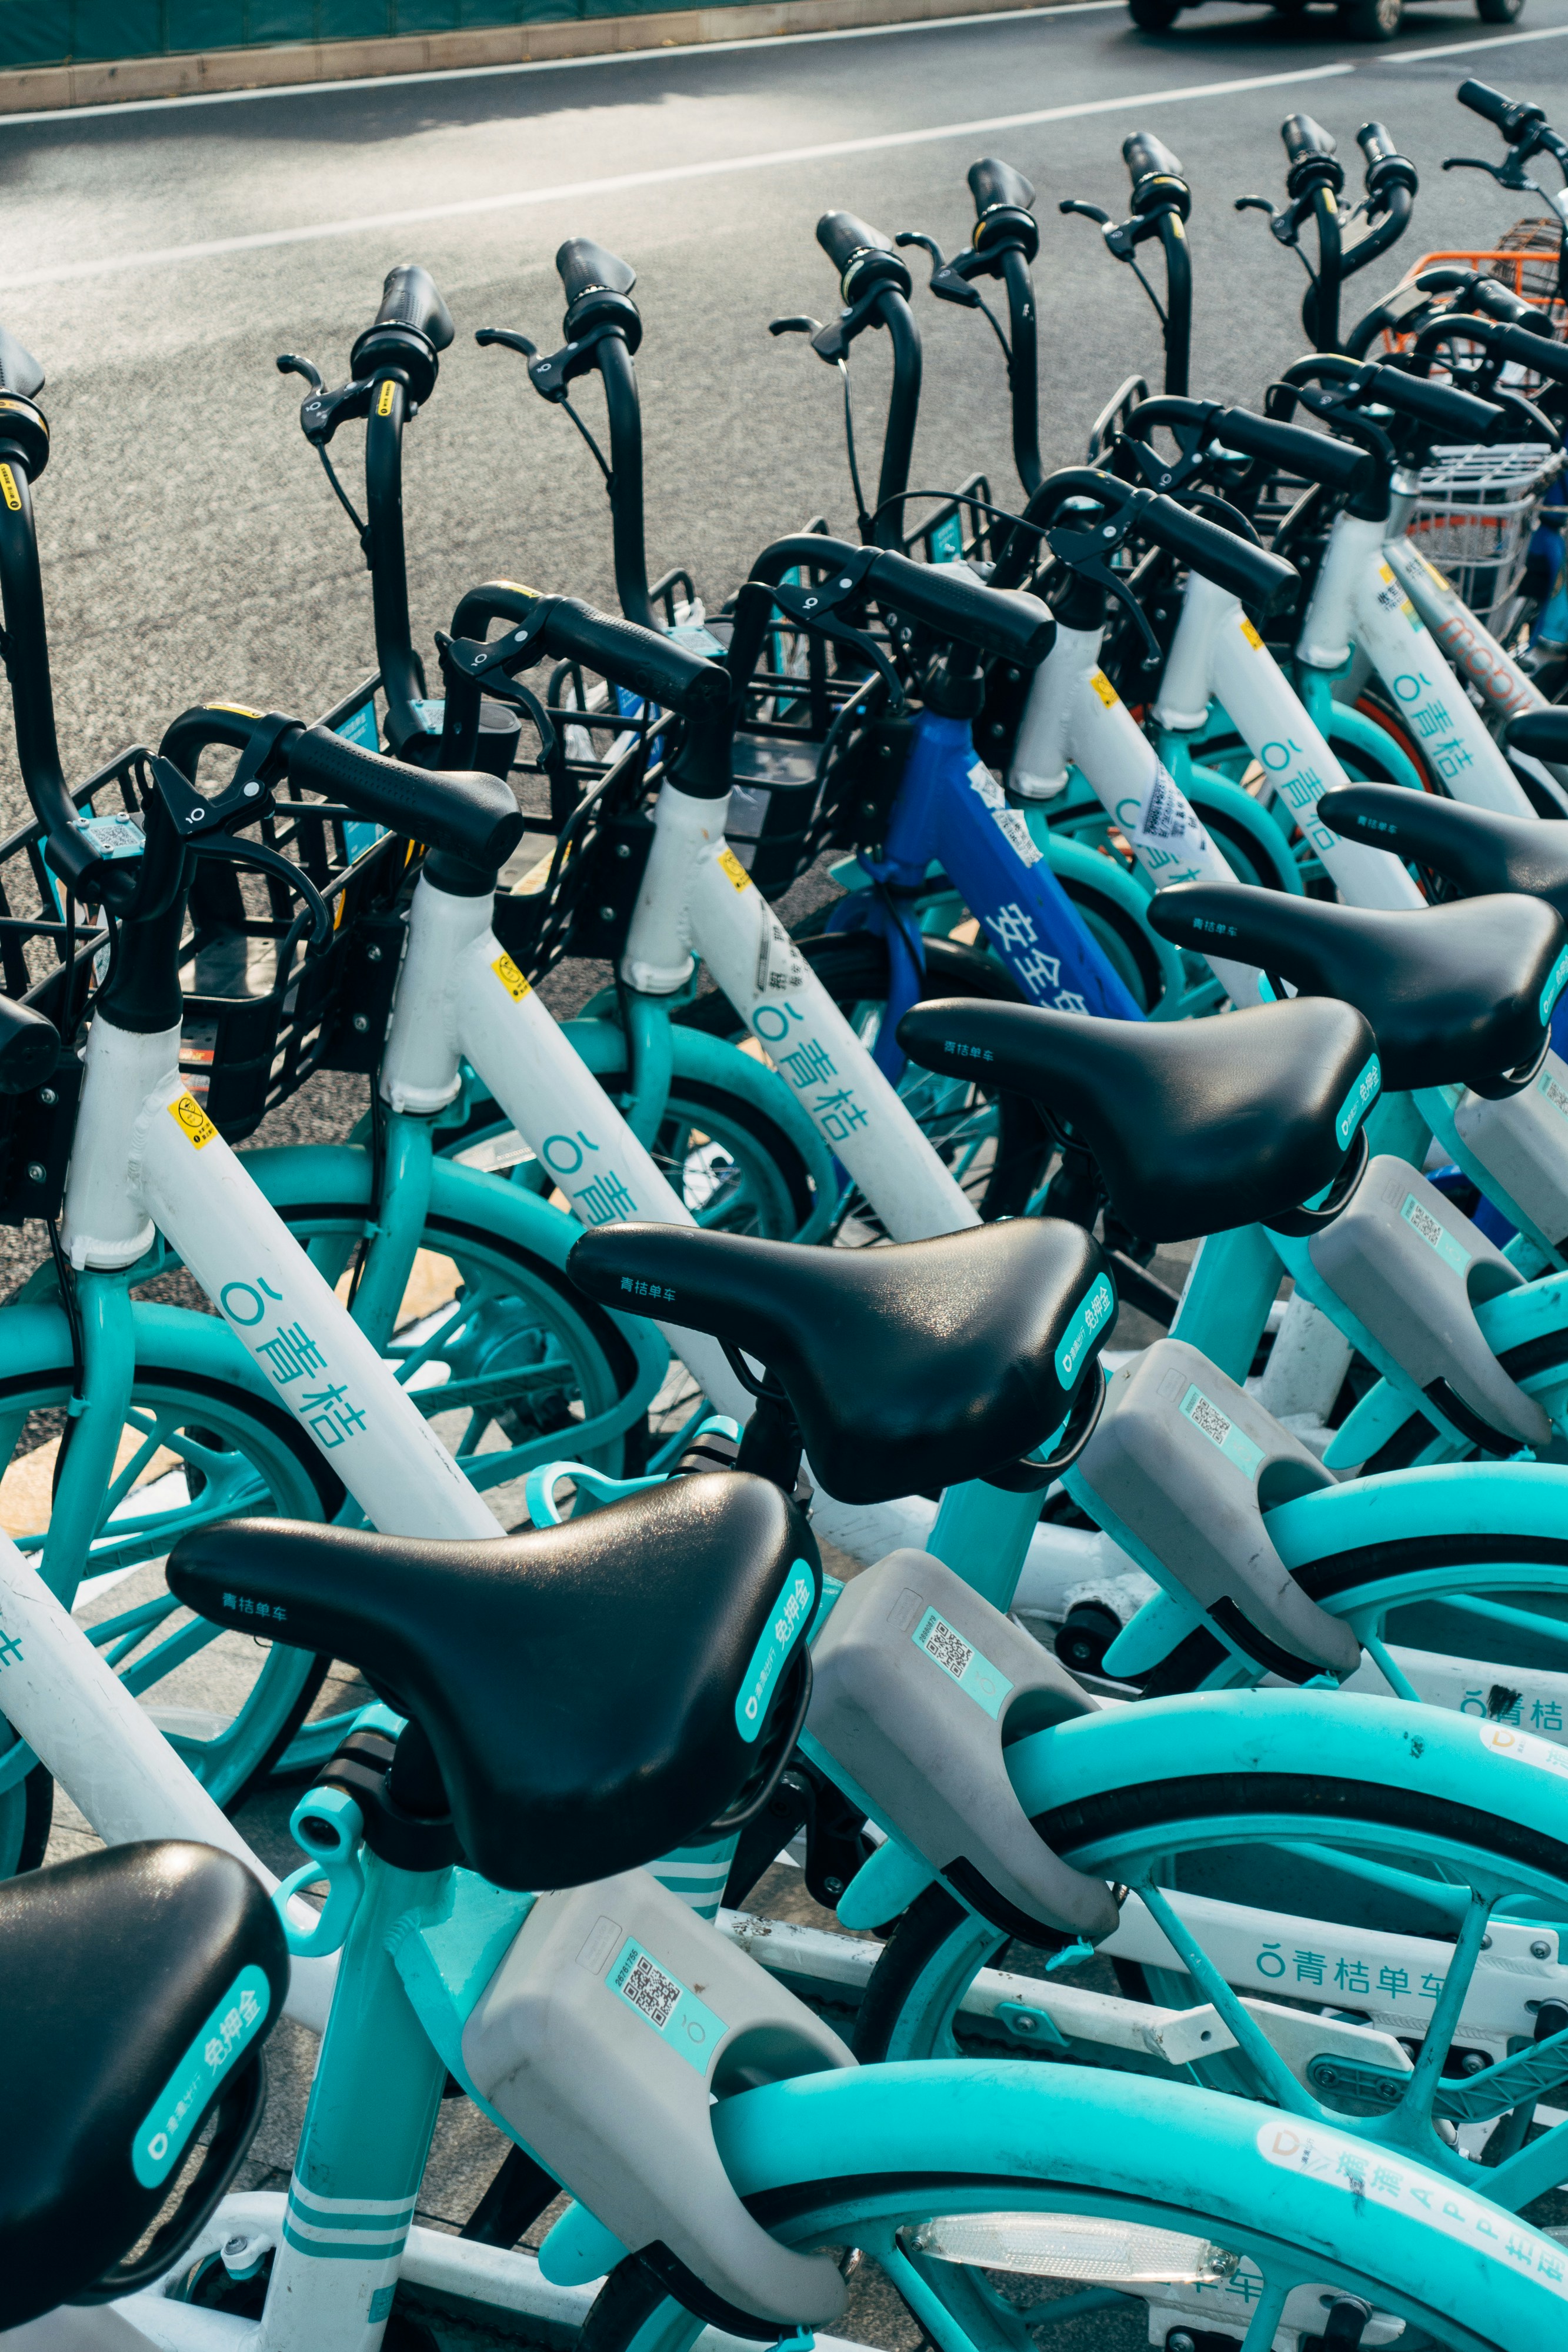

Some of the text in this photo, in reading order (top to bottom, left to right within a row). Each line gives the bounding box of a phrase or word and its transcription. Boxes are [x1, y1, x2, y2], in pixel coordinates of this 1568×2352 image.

[1411, 699, 1474, 778] 青桔
[944, 1040, 994, 1062] 青桔单车
[780, 1039, 869, 1142] 青桔
[573, 1170, 638, 1226] 青
[620, 1277, 676, 1302] 青桔单车
[1085, 1286, 1110, 1335] 免押金
[255, 1322, 364, 1449] 青桔
[222, 1592, 287, 1622] 青桔单车
[775, 1579, 810, 1652] 免押金
[1293, 1950, 1445, 1999] 青桔单车
[203, 1990, 261, 2077] 免押金
